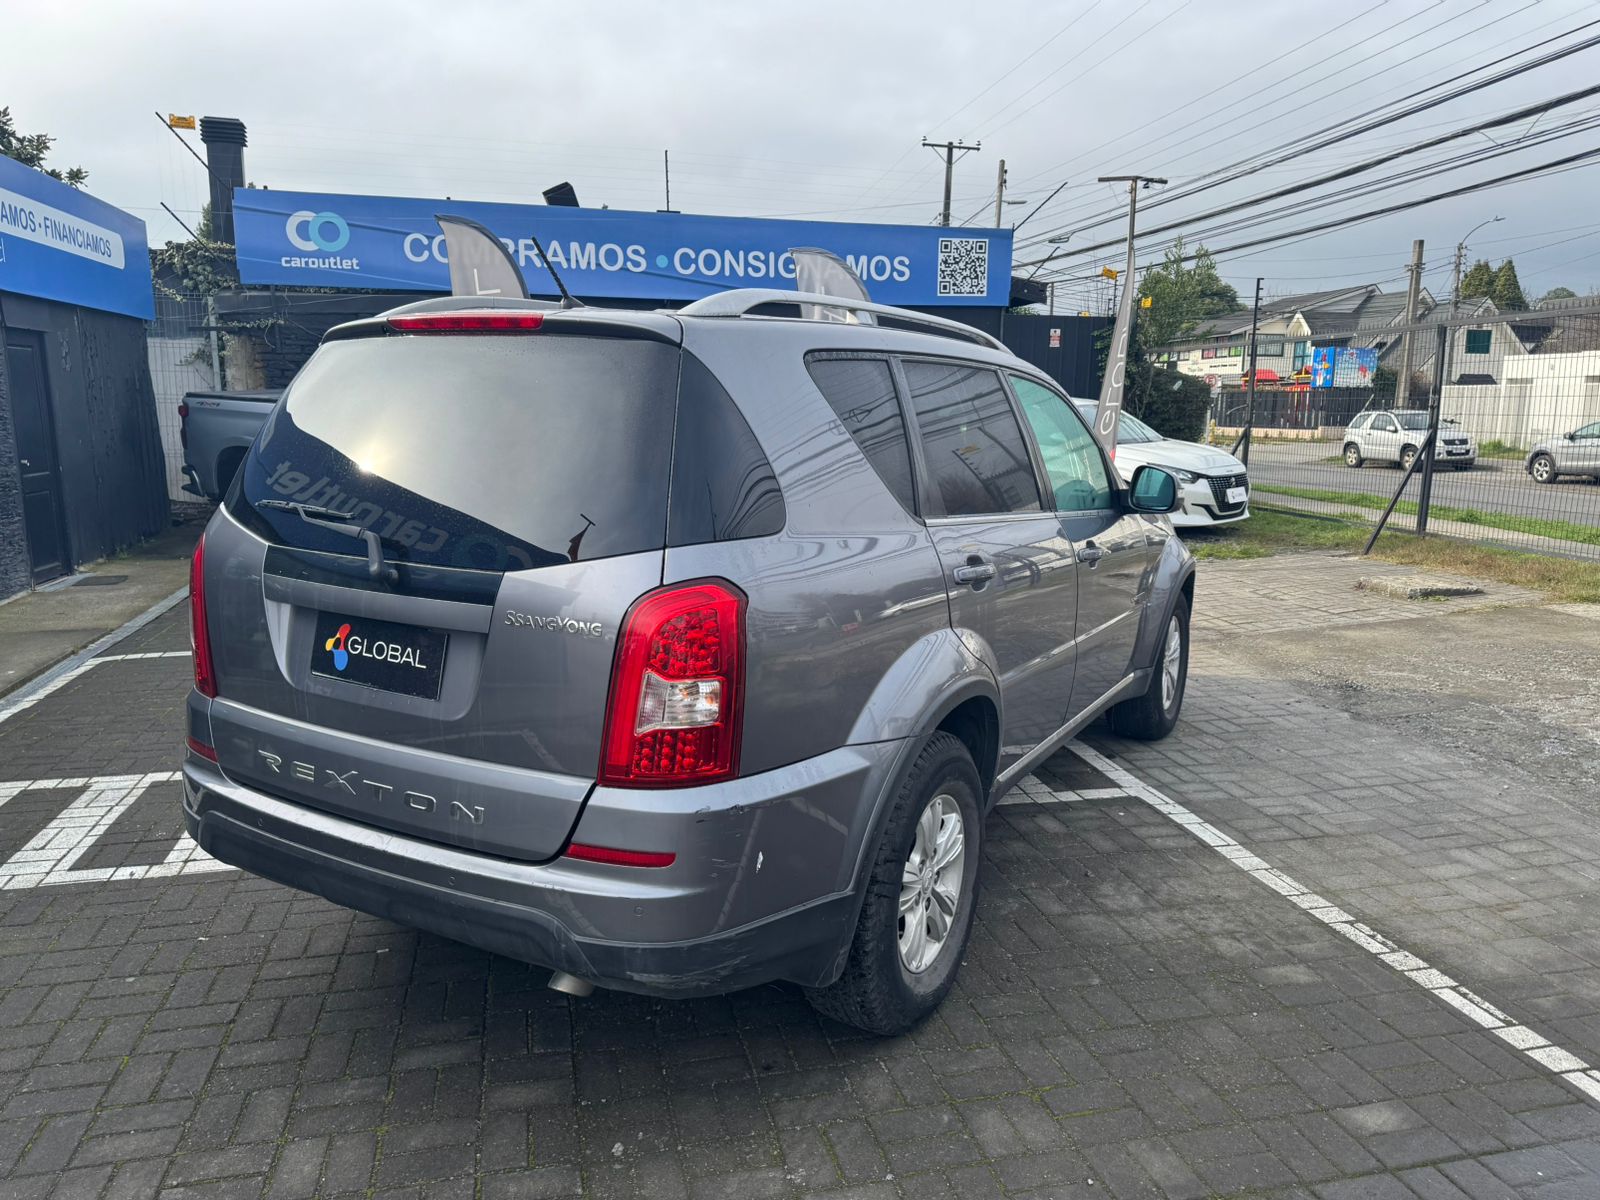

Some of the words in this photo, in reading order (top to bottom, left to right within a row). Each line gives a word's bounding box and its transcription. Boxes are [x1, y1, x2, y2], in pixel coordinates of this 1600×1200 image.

[43, 216, 112, 258] FINANCIAMOS
[281, 256, 360, 270] caroutlet
[348, 636, 427, 669] GLOBAL
[258, 749, 485, 825] REXTON
